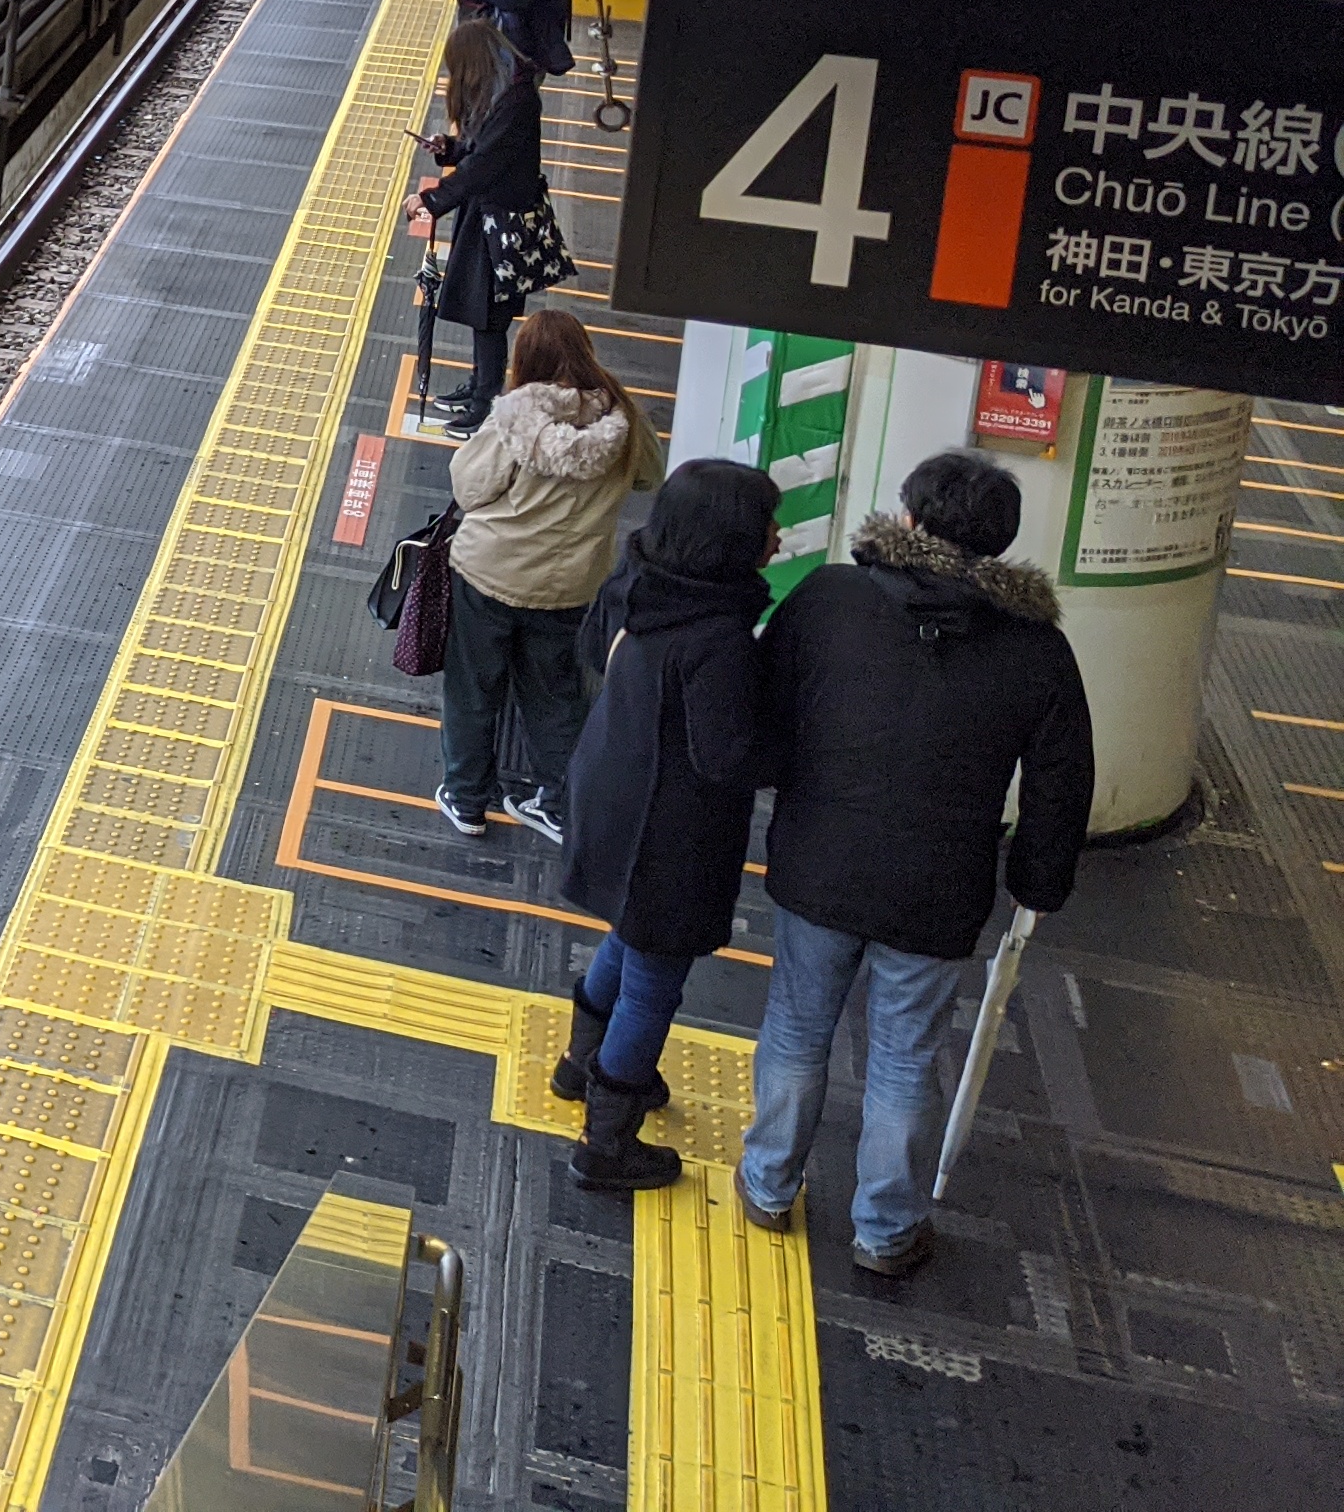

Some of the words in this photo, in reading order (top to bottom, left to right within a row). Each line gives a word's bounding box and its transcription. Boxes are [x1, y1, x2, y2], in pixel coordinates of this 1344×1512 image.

[970, 90, 1024, 127] JC
[1062, 83, 1322, 177] 中央線
[699, 54, 891, 288] 4
[1054, 166, 1186, 217] Chūō
[1204, 186, 1311, 232] Line
[1040, 279, 1081, 310] for
[1090, 286, 1189, 324] Kanda
[1201, 301, 1222, 325] &
